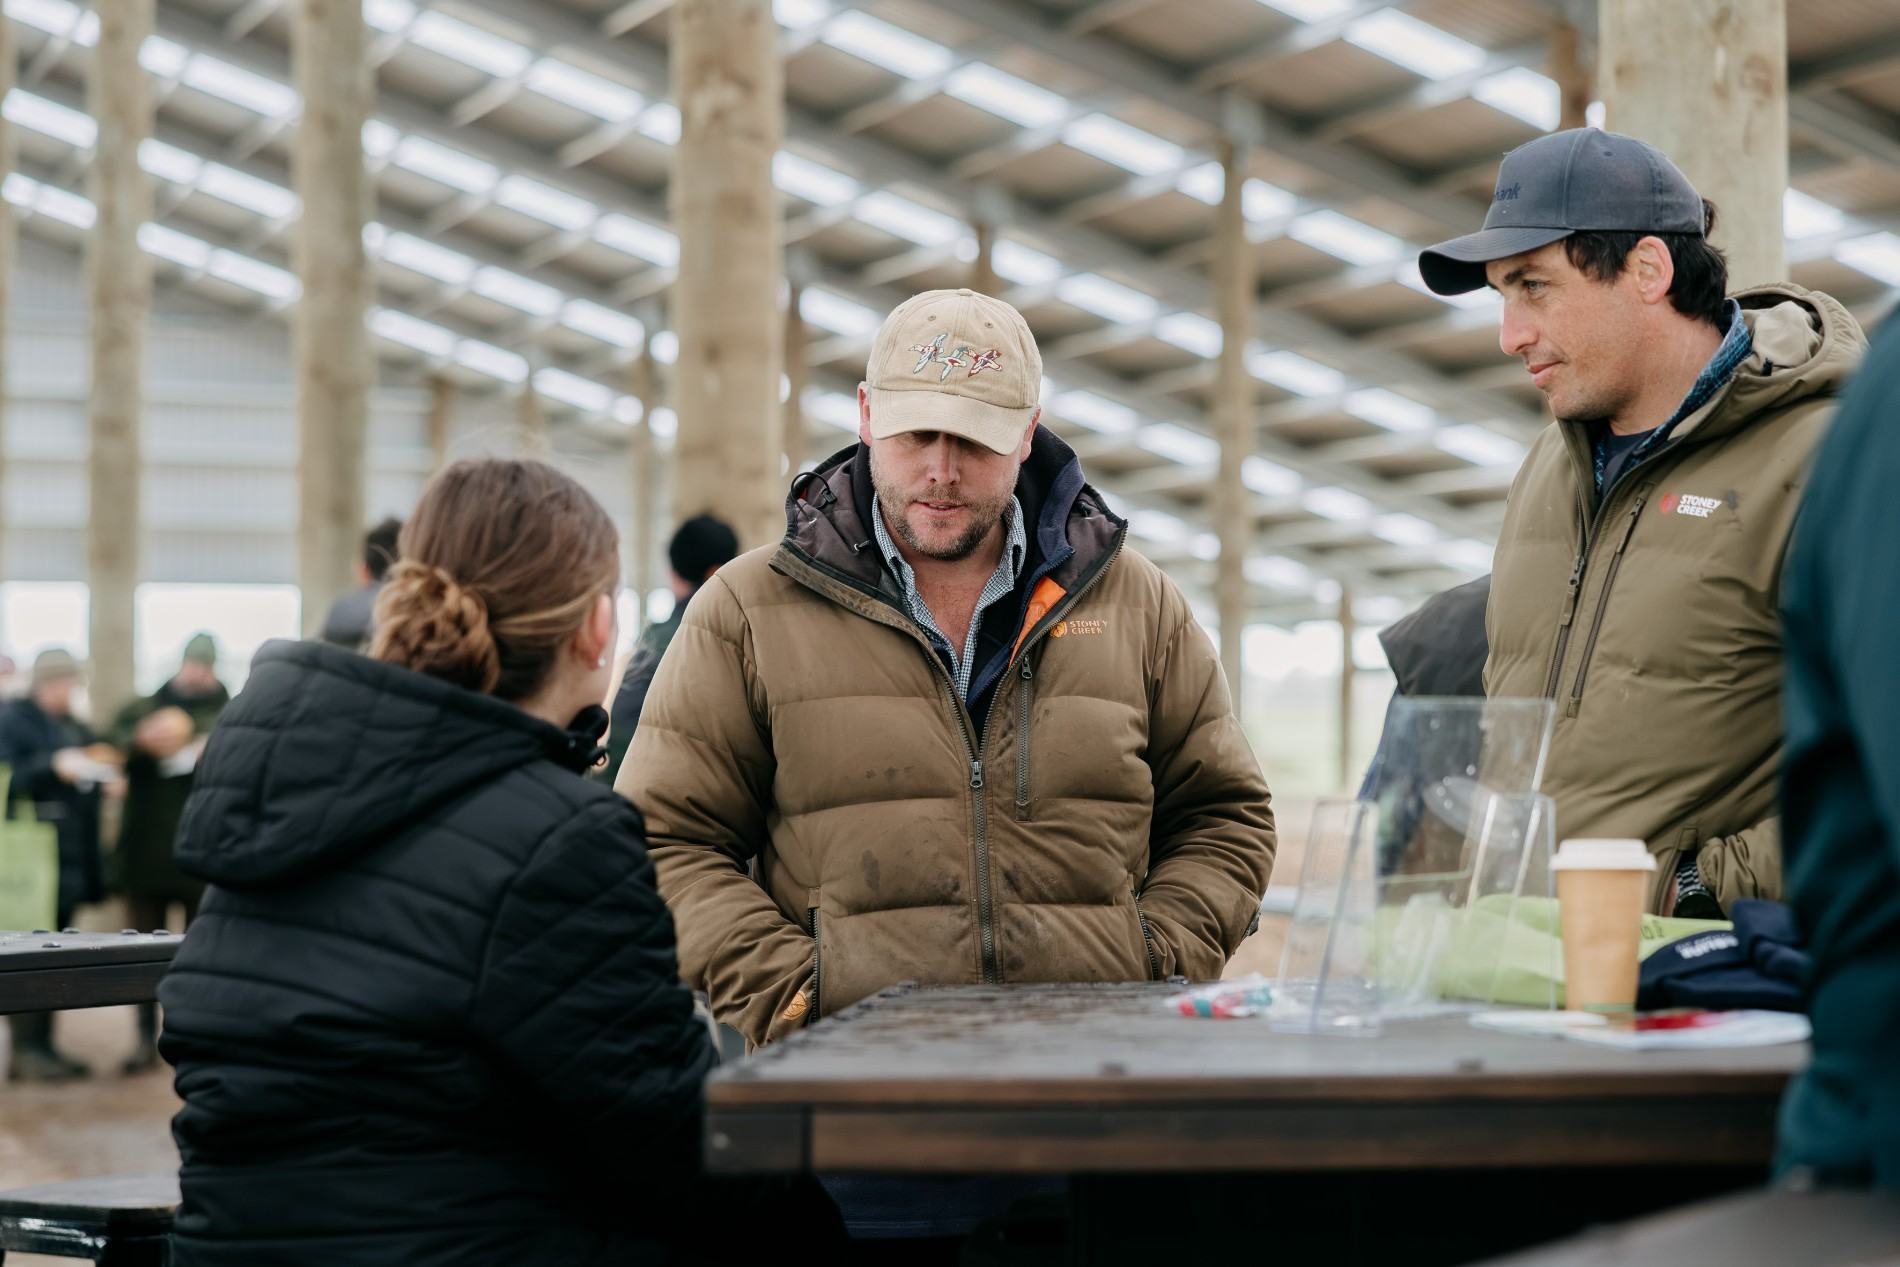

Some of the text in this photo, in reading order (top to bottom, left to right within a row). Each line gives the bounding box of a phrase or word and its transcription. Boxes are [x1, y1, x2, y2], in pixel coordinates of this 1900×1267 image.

[1680, 494, 1722, 509] STONEY
[1676, 503, 1713, 518] CREEK
[1069, 620, 1108, 628] STONEY
[1071, 627, 1103, 635] CREEK
